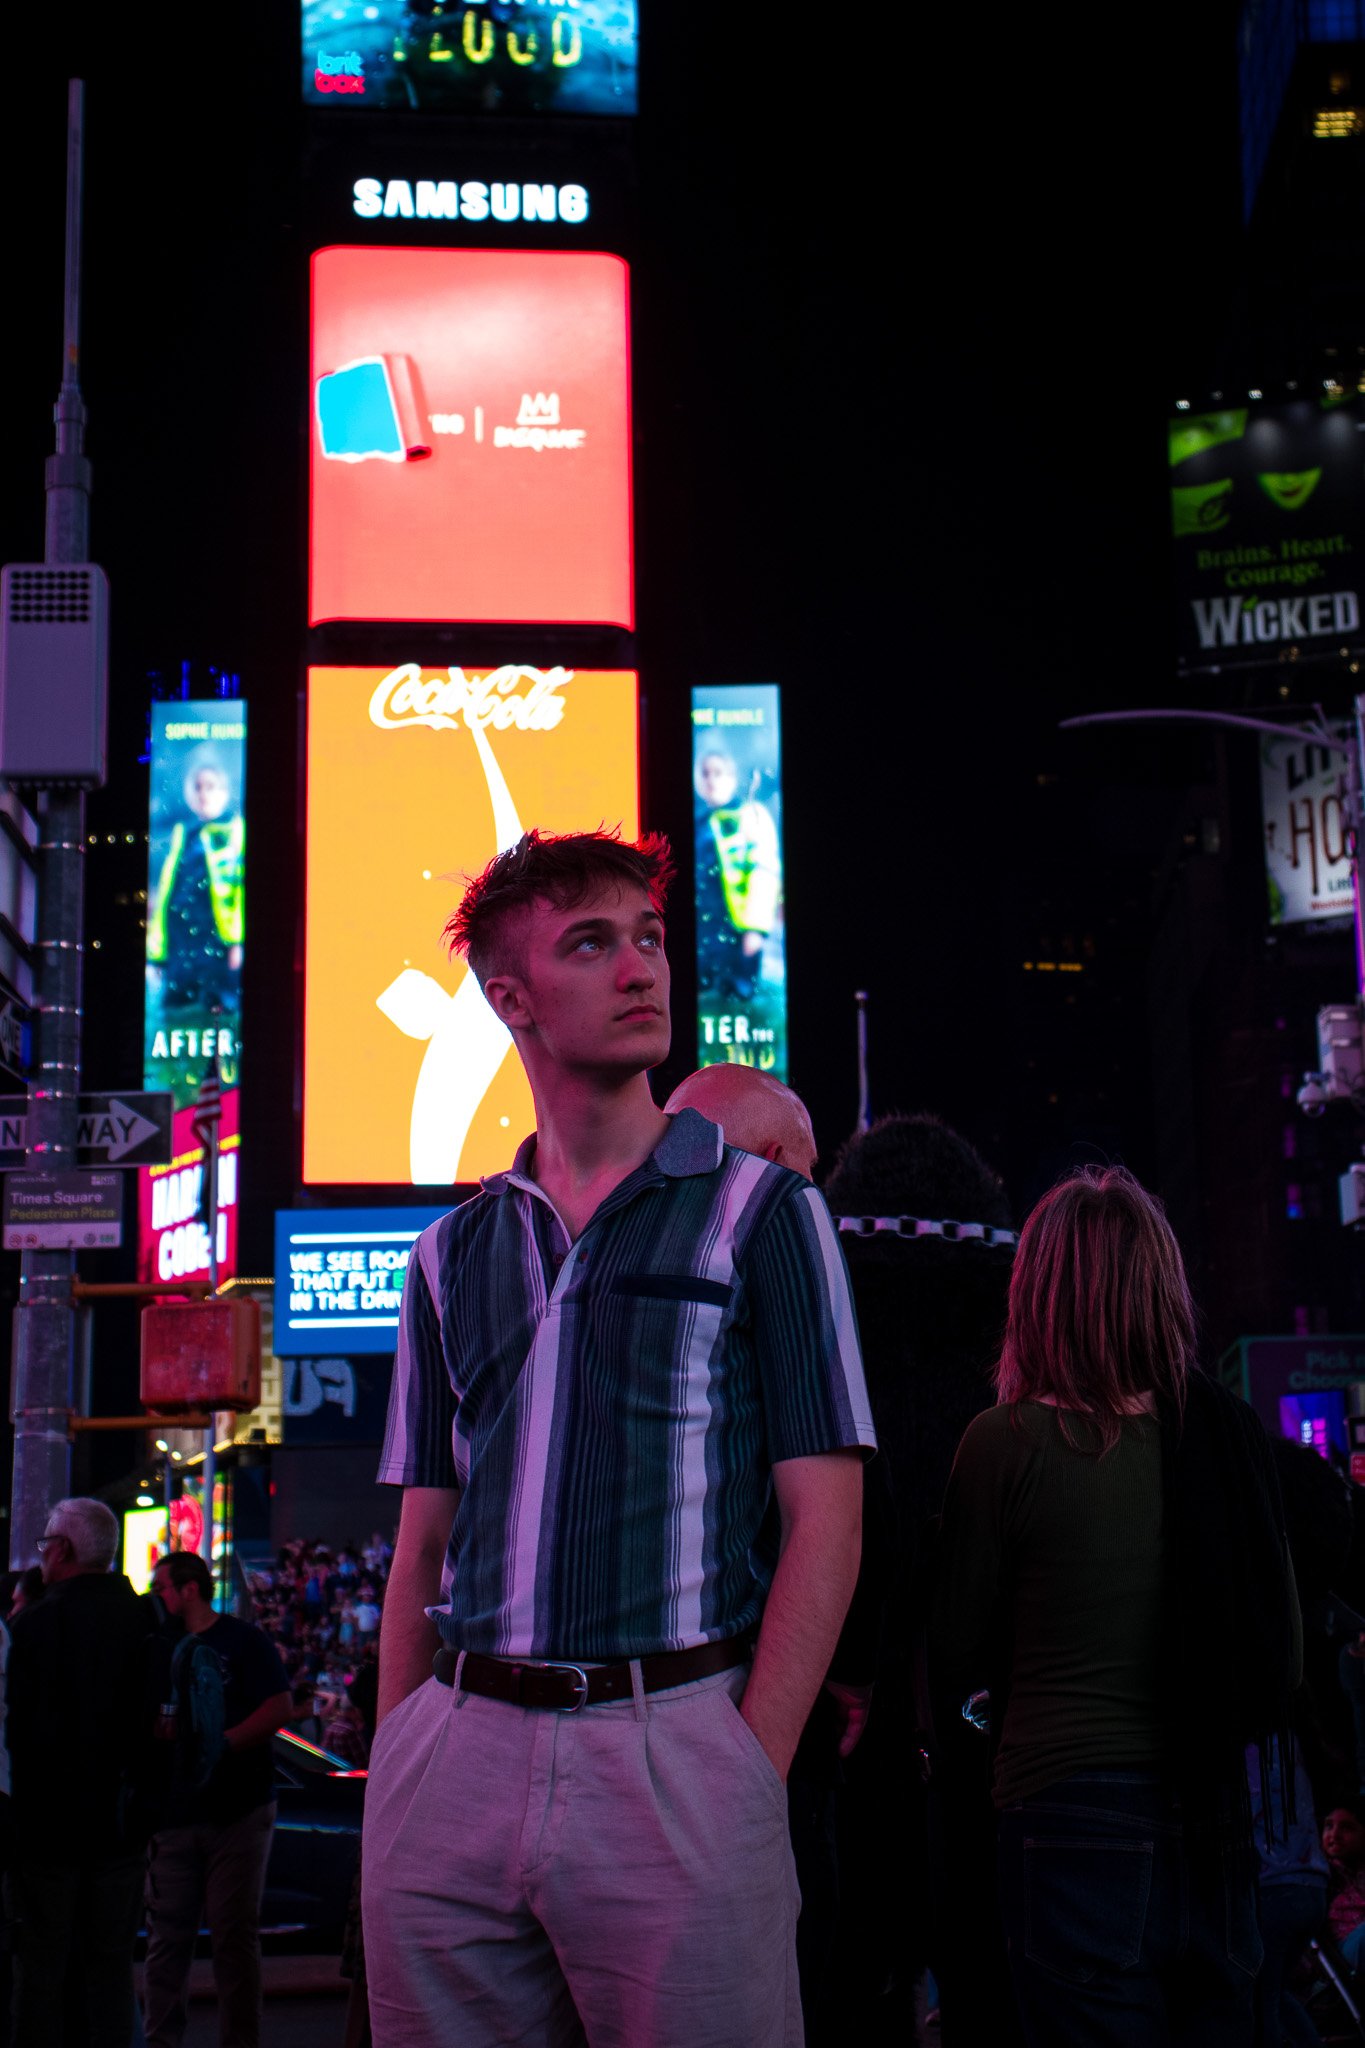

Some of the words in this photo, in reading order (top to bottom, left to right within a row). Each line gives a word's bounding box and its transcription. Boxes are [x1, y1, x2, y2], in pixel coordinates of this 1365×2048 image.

[315, 69, 365, 94] box
[353, 178, 589, 223] SAMSUNG
[701, 1014, 749, 1044] TER
[152, 1028, 234, 1058] AFTER
[10, 1191, 51, 1205] Times
[53, 1191, 103, 1206] Square
[10, 1208, 78, 1220] Pedestrian
[80, 1207, 117, 1219] Plaza
[290, 1252, 324, 1272] WE
[326, 1251, 367, 1271] SEE
[290, 1271, 345, 1291] THAT
[348, 1270, 389, 1290] PUT
[290, 1291, 313, 1311] IN
[315, 1290, 358, 1310] THE
